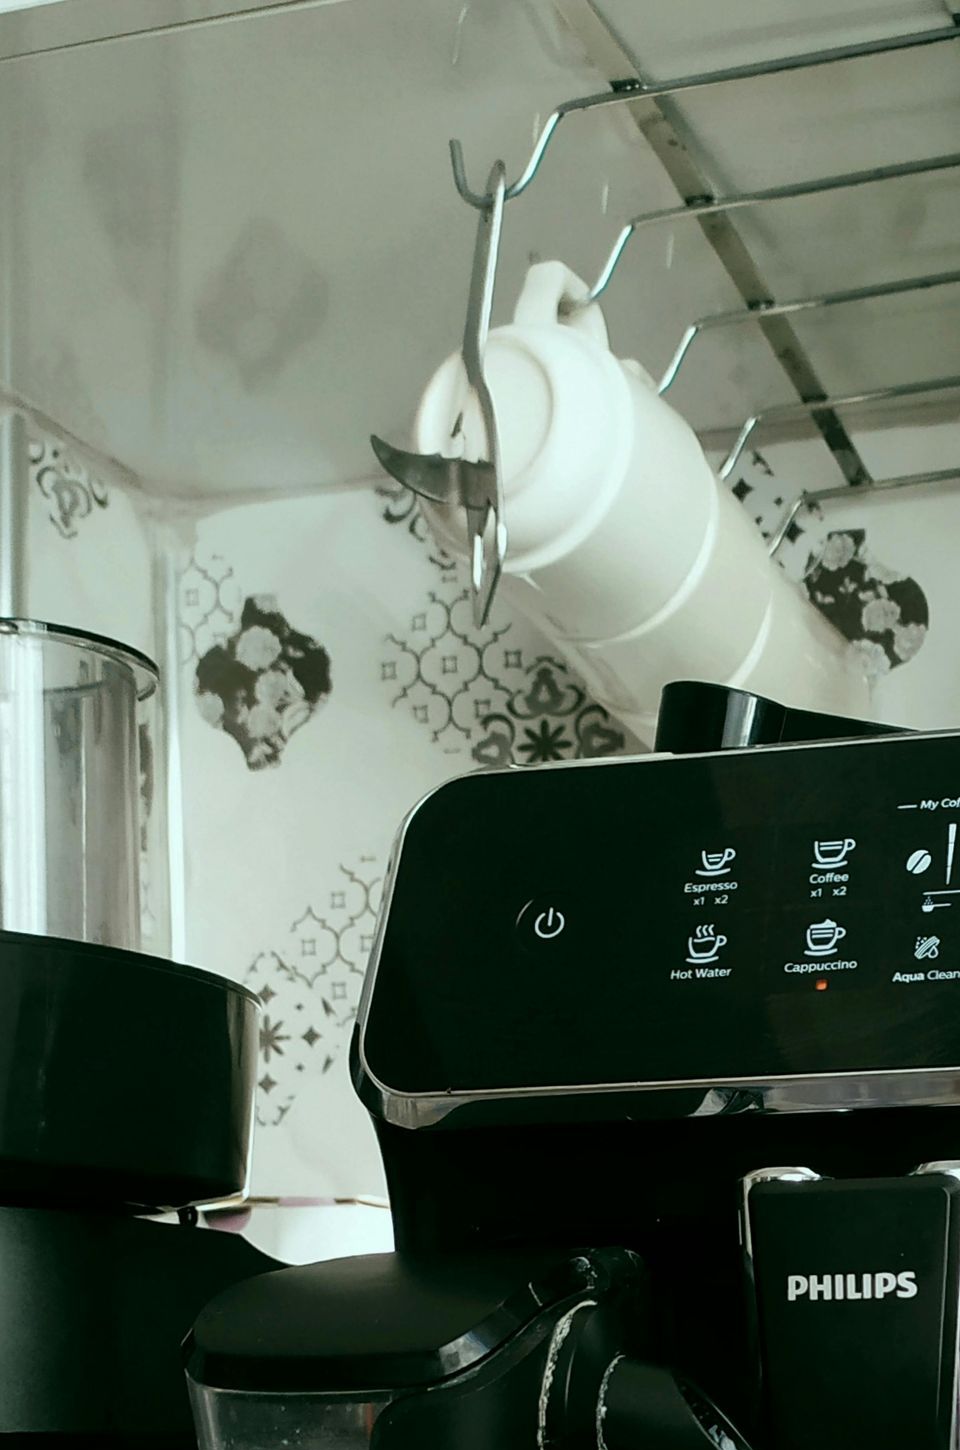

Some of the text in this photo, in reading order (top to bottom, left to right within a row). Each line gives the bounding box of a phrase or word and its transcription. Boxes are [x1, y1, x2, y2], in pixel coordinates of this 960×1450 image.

[920, 799, 938, 811] My
[809, 872, 849, 884] Coffee
[684, 881, 738, 893] Espresso
[810, 886, 847, 897] x1 x2
[693, 895, 729, 906] x1 x2
[784, 959, 858, 974] Cappuccino
[670, 967, 732, 980] Hot Water
[892, 969, 960, 983] Aqua Clean
[787, 1271, 918, 1301] PHILIPS
